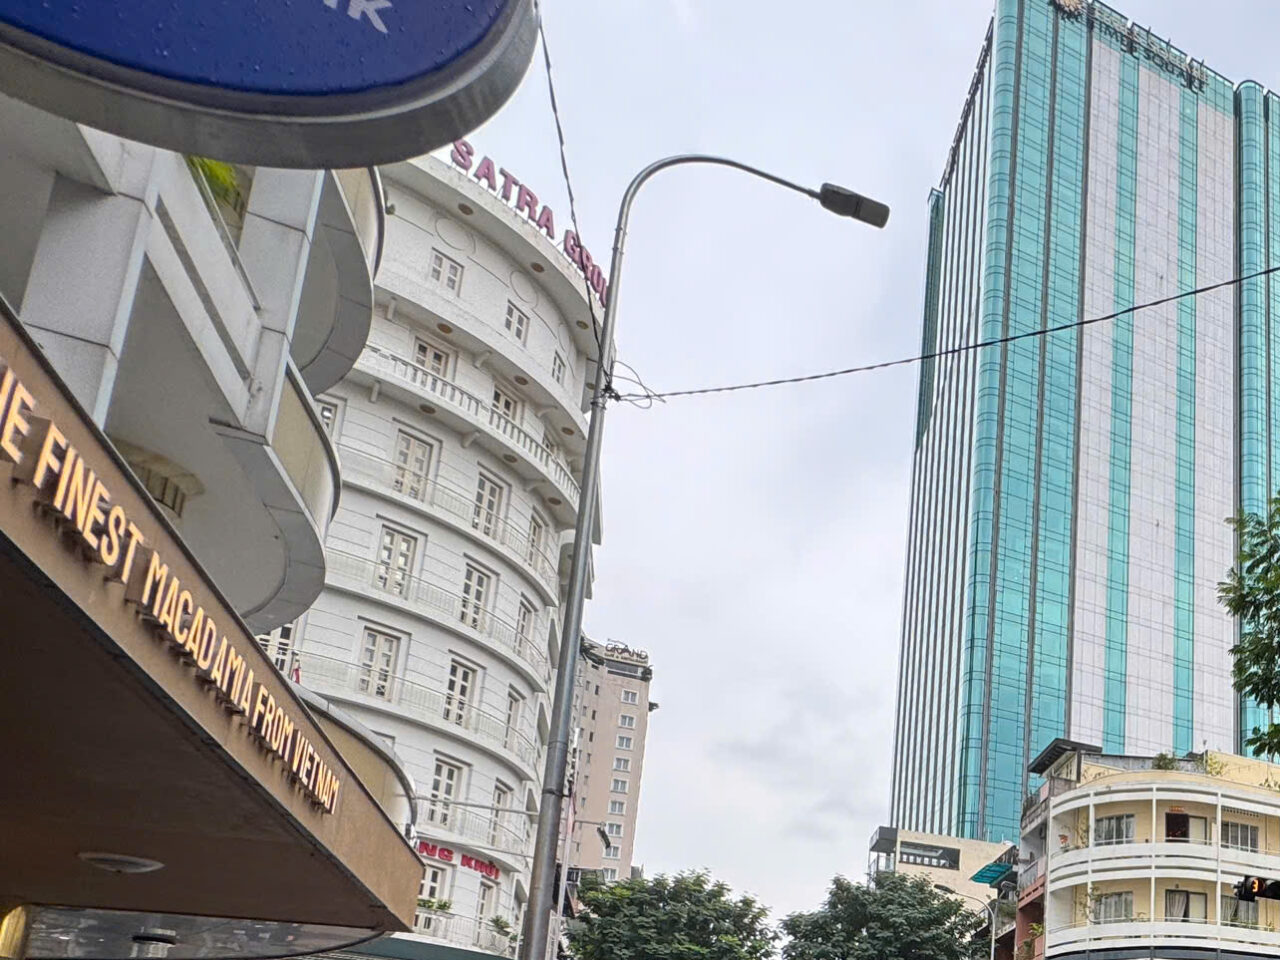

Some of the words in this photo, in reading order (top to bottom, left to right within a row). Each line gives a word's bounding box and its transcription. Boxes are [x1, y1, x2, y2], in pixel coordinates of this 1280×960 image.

[451, 138, 555, 240] SATRA
[33, 422, 144, 585] FINEST
[142, 551, 254, 717] MACADAMIA
[252, 685, 294, 762] FROM
[292, 730, 340, 815] VIETNAM
[418, 841, 454, 862] NG
[1251, 878, 1259, 892] 3
